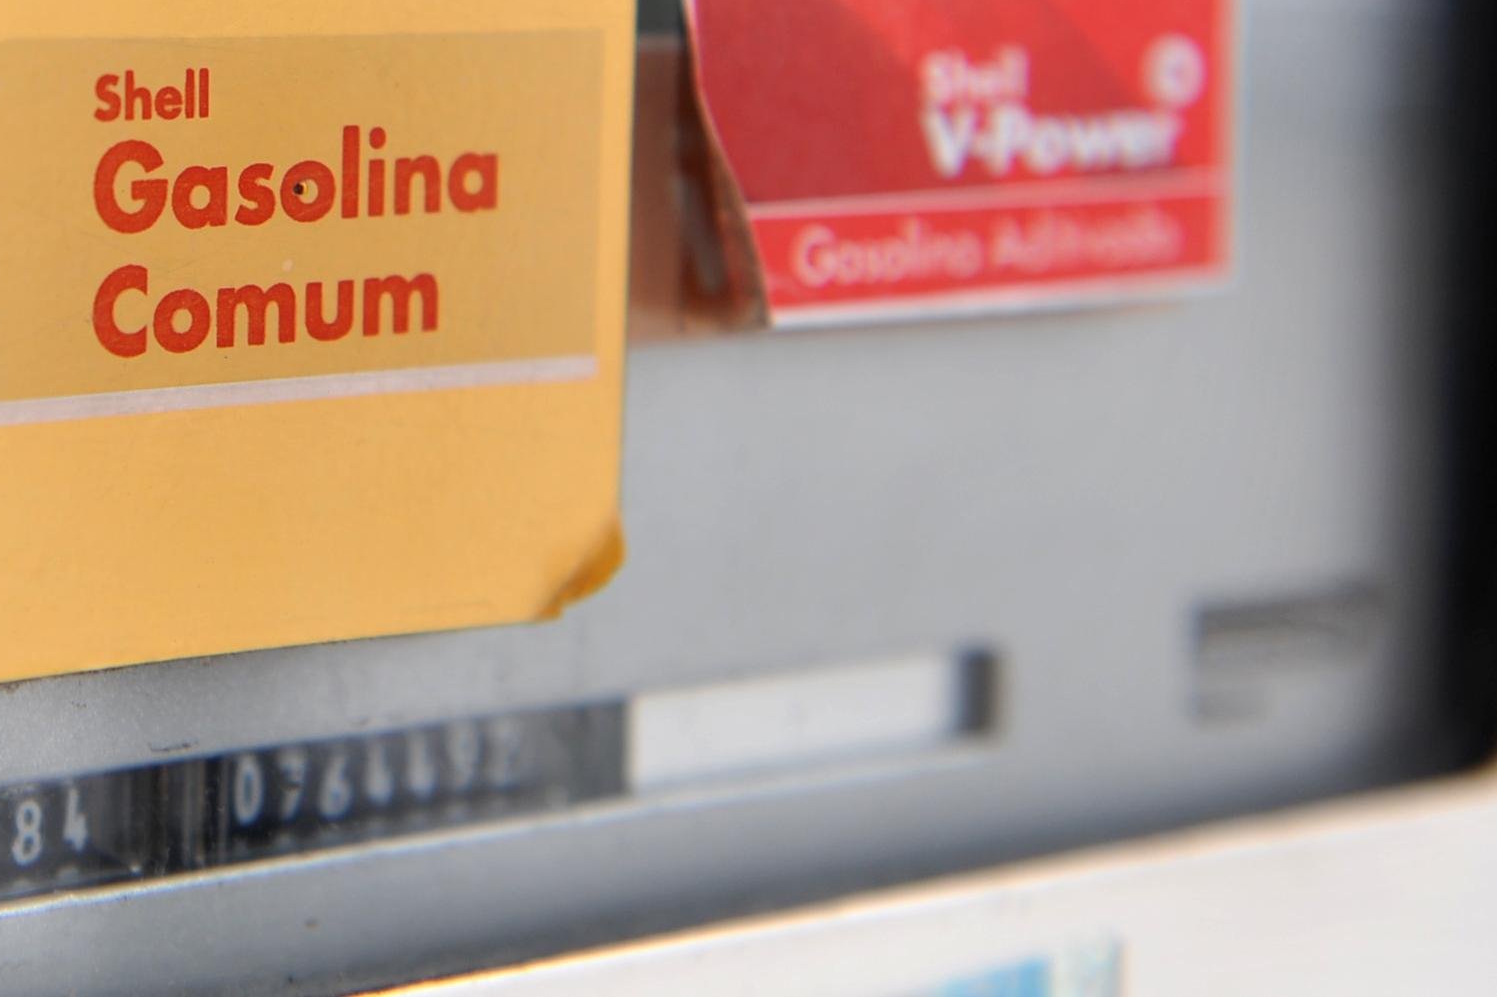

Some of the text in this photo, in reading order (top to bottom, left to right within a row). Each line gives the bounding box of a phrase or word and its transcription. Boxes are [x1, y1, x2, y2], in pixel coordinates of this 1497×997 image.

[94, 68, 210, 122] Shell
[920, 47, 1029, 103] Shell
[922, 107, 1182, 177] V-Power
[94, 125, 499, 234] Gasolina
[792, 217, 984, 287] Gasolina
[93, 264, 439, 358] Comum
